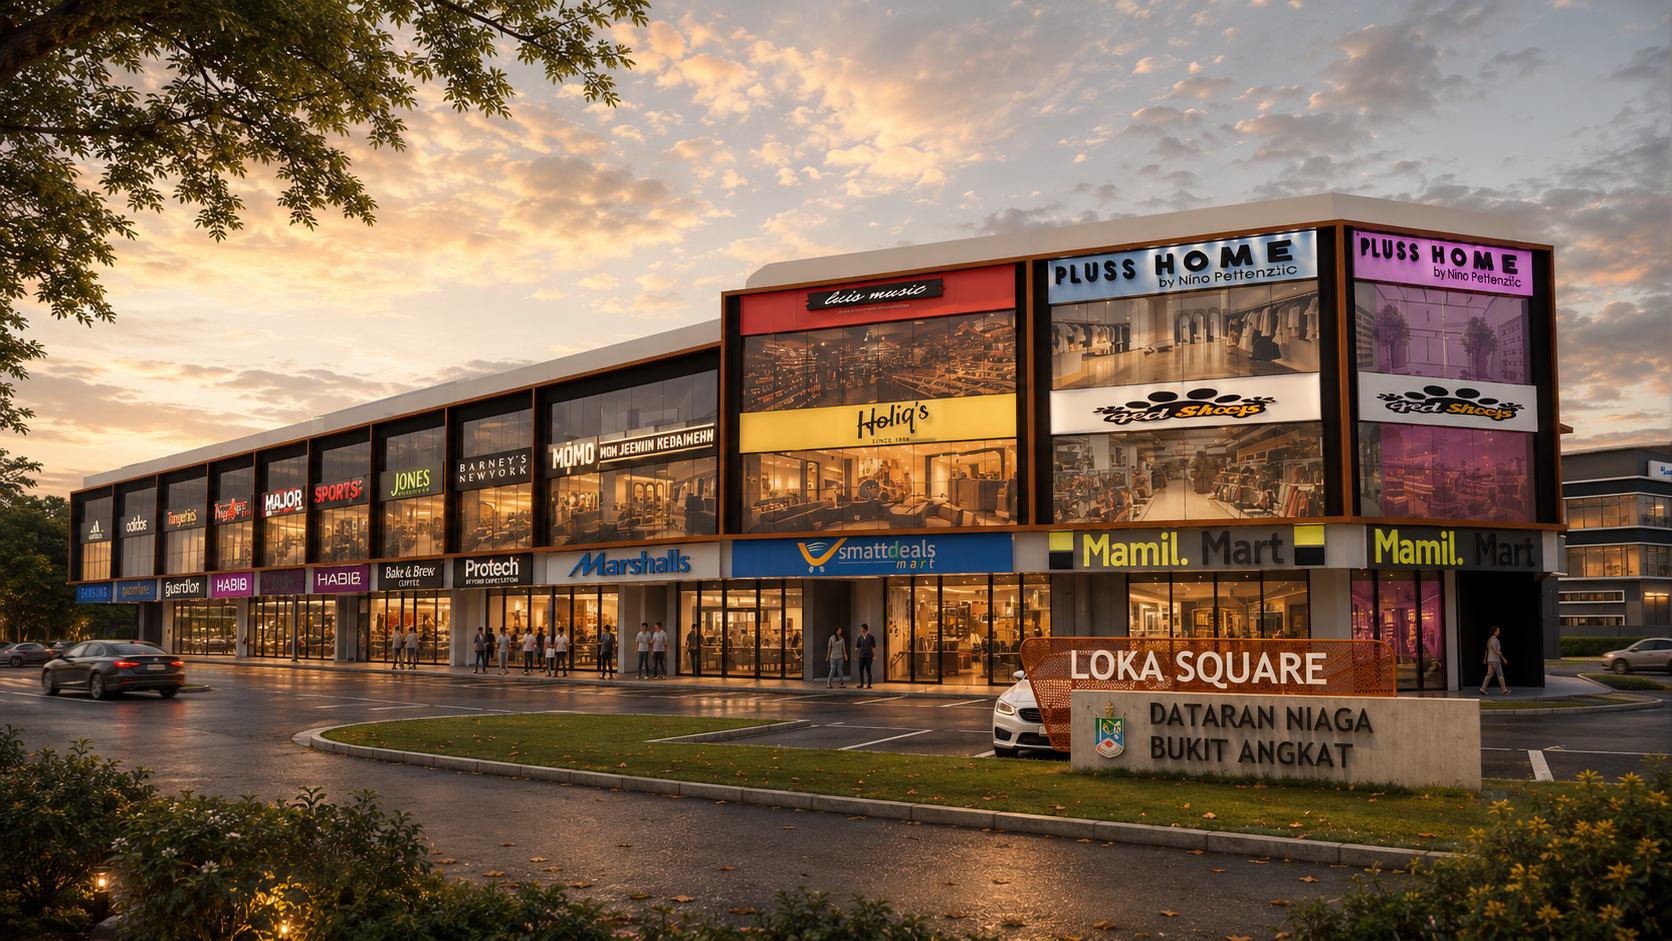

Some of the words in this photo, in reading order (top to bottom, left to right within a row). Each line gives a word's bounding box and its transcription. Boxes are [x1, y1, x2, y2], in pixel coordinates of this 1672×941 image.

[1055, 258, 1136, 285] PLUSS
[1155, 239, 1293, 276] HOME
[1361, 237, 1419, 262] PLUSS
[1432, 245, 1518, 274] HOME
[1158, 277, 1176, 289] by
[1179, 273, 1210, 286] Nino
[1433, 266, 1445, 280] by
[1448, 268, 1469, 281] Nino
[869, 284, 927, 300] music
[459, 454, 527, 473] BARNEY'S
[391, 469, 430, 496] JONES
[265, 489, 302, 511] MAJOR
[838, 539, 936, 560] smattdeals
[1201, 530, 1284, 566] Mart
[1475, 533, 1535, 567] Mart
[385, 566, 404, 579] Bake
[413, 565, 435, 577] Brew
[465, 556, 519, 577] Protech
[568, 548, 691, 577] Marshalls
[896, 559, 935, 569] mart
[216, 578, 248, 592] HABIB
[1070, 649, 1164, 682] LOKA
[1176, 651, 1327, 689] SQUARE
[1150, 702, 1274, 729] DATARAN
[1286, 705, 1374, 733] NIAGA
[1150, 735, 1229, 762] BUKIT
[1238, 739, 1354, 768] ANGKAT
